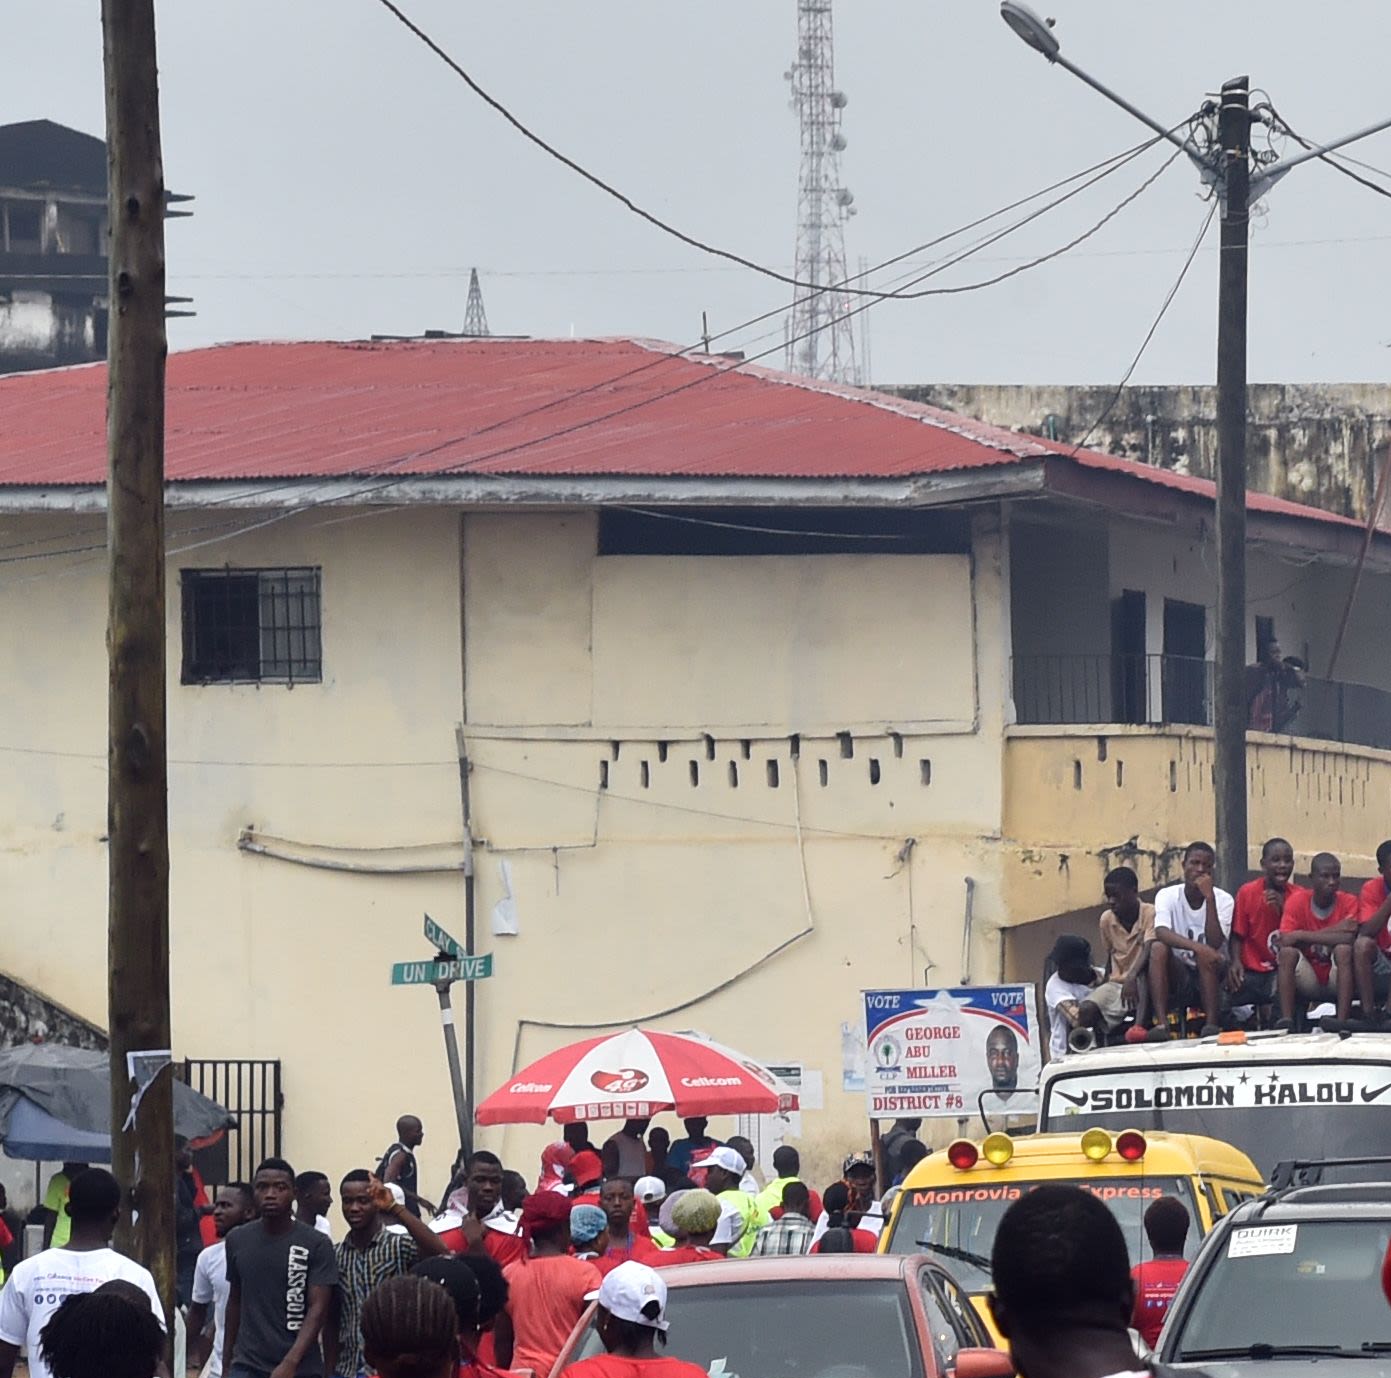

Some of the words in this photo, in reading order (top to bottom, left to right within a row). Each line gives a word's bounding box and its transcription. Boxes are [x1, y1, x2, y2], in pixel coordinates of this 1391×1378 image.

[426, 919, 451, 952] CLAY
[403, 964, 426, 982] UN
[439, 959, 485, 979] DRIVE
[867, 995, 901, 1009] VOTE
[991, 992, 1025, 1006] VOTE
[905, 1026, 961, 1041] GEORGE
[905, 1045, 931, 1059] ABU
[906, 1065, 957, 1079] MILLER
[681, 1076, 742, 1088] Cellcom
[873, 1095, 942, 1111] DISTRICT
[945, 1094, 963, 1109] #8
[1091, 1084, 1235, 1111] SOLOMON
[1254, 1081, 1355, 1104] KALOU
[913, 1185, 1021, 1206] Monrovia
[1079, 1184, 1163, 1200] xpress
[1237, 1227, 1293, 1239] QUIRK
